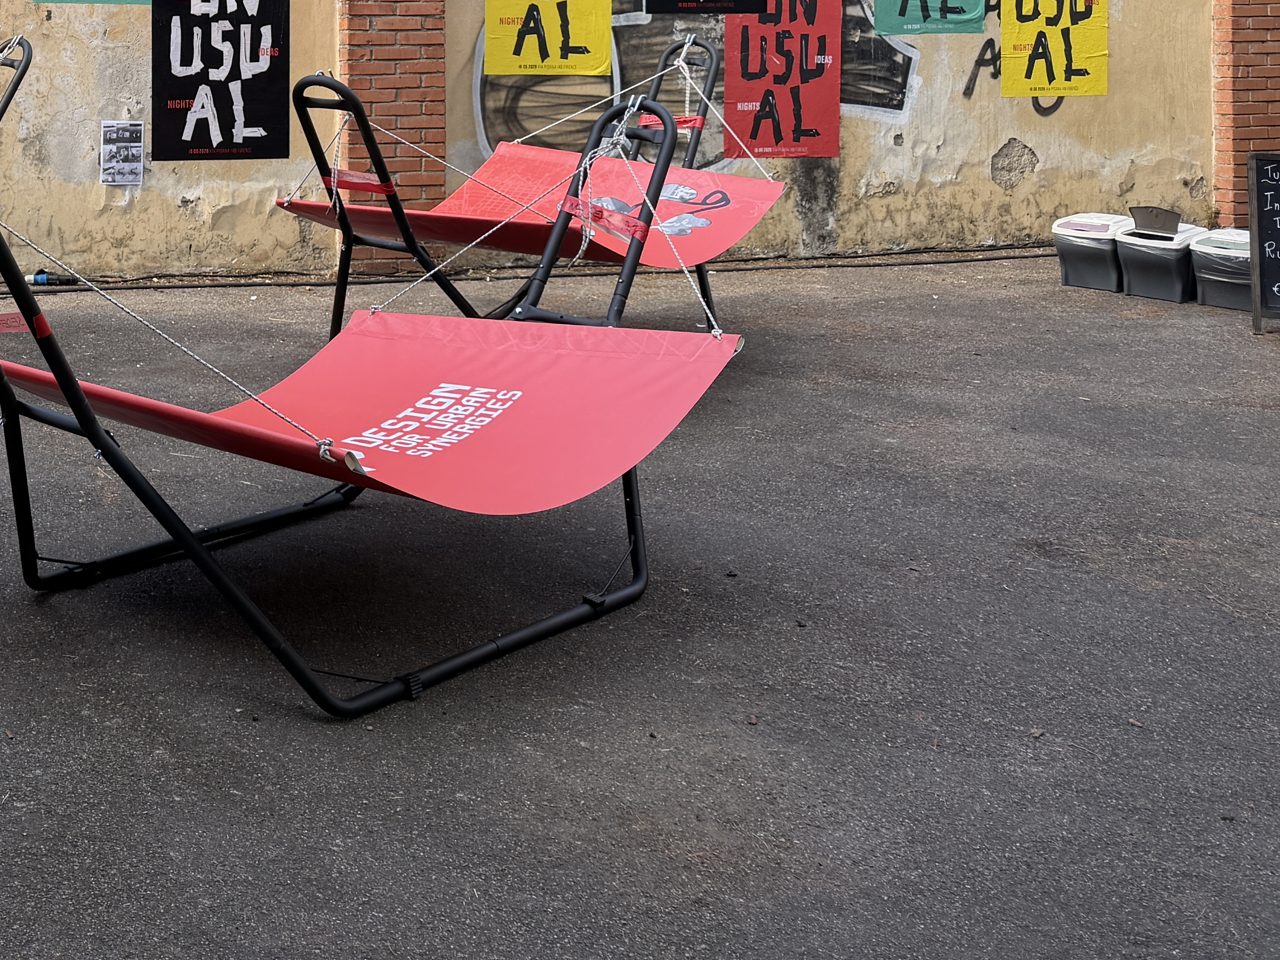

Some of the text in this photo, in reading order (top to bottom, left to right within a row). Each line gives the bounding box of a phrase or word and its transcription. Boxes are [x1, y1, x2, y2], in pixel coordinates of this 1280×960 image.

[170, 15, 272, 82] USU
[258, 47, 279, 57] IDEAS
[499, 17, 524, 26] NIGHTS
[512, 0, 592, 64] AL
[1012, 43, 1034, 52] NIGHTS
[740, 25, 827, 86] USU
[814, 55, 833, 64] IDEAS
[1024, 26, 1091, 86] AL
[167, 100, 194, 109] NIGHTS
[181, 79, 268, 148] AL
[737, 102, 760, 111] NIGHTS
[749, 85, 821, 146] AL
[341, 383, 472, 448] DESIGN
[379, 387, 498, 453] FOR URBAN
[405, 389, 523, 458] SYNERGIES
